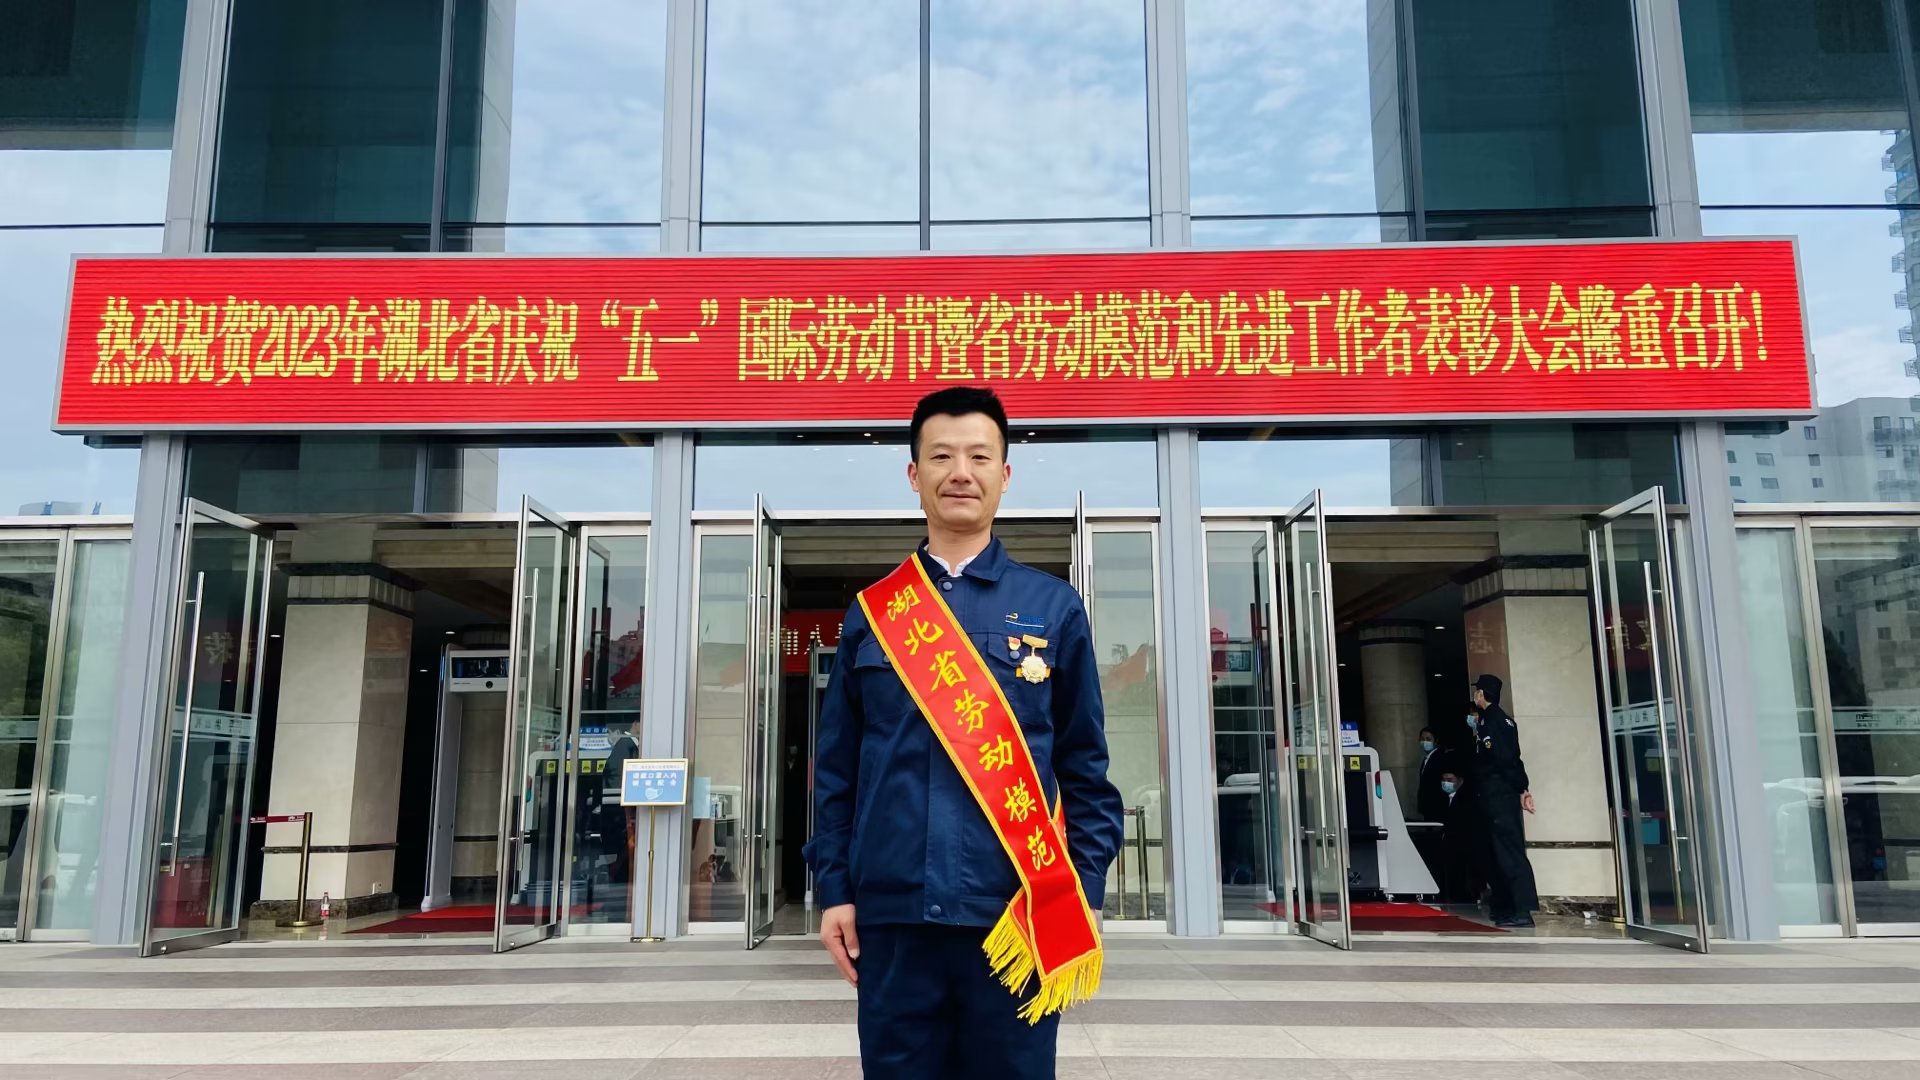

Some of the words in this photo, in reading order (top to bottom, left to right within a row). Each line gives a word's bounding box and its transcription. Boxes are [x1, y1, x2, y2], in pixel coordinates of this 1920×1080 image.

[886, 583, 1057, 871] 湖北省劳动模范
